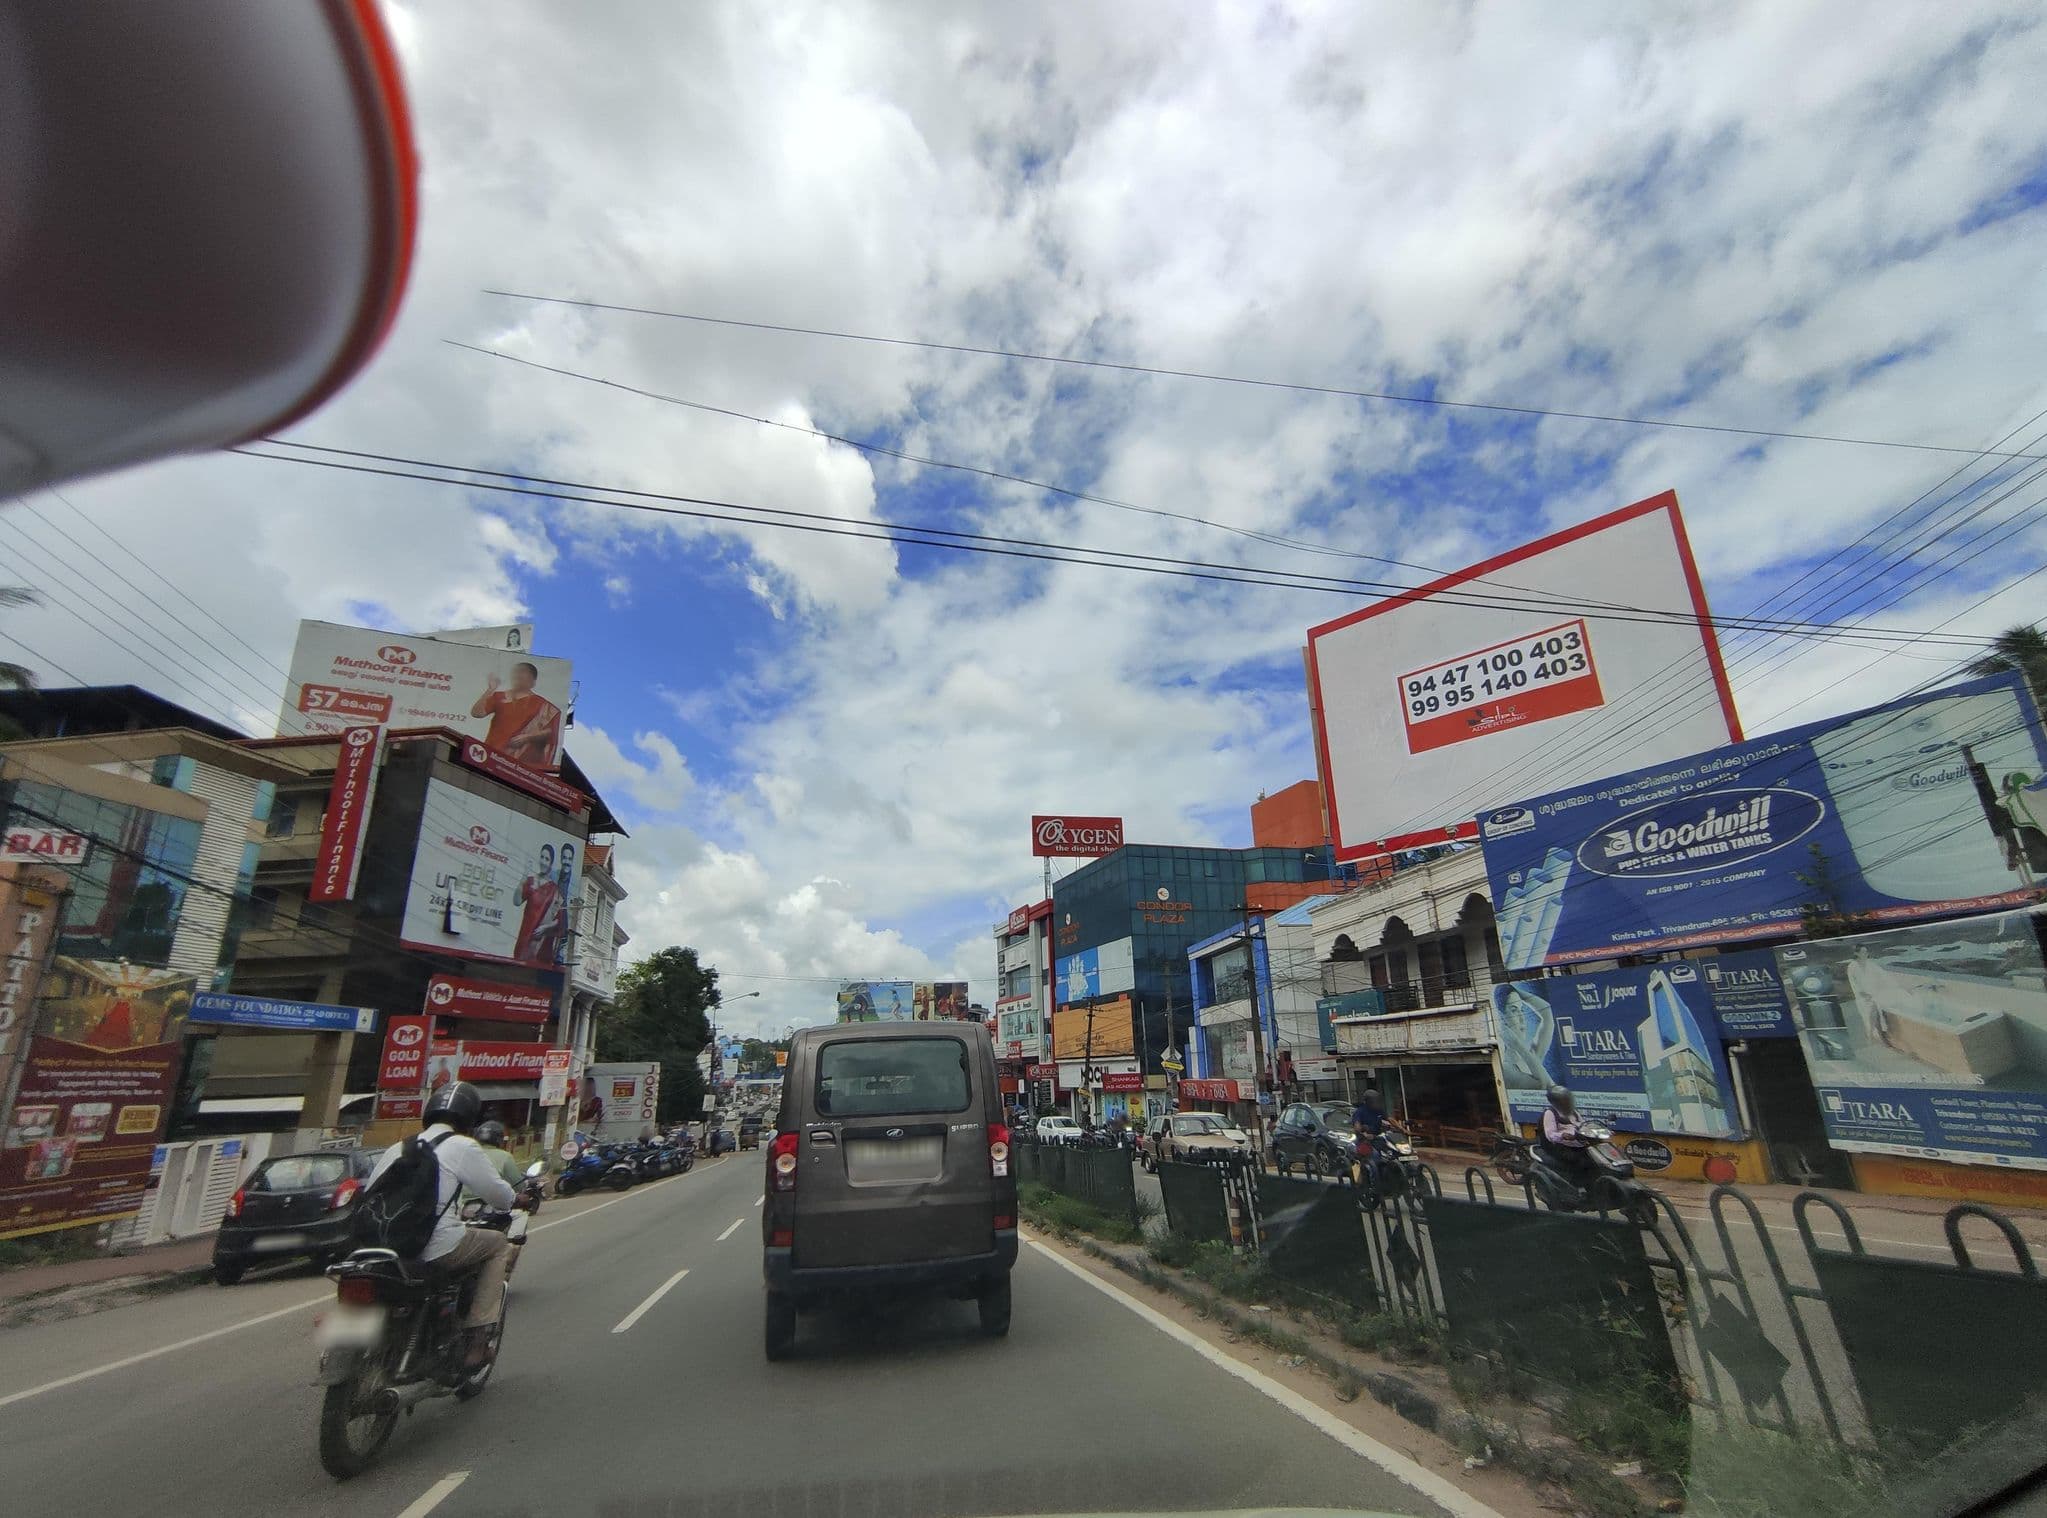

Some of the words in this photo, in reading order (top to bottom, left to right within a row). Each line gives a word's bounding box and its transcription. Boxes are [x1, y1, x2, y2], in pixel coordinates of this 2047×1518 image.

[334, 655, 396, 674] Muthoot
[399, 665, 453, 682] Finance
[1408, 675, 1437, 698] 94
[1441, 664, 1470, 686] 47
[1476, 648, 1523, 676] 100
[1529, 631, 1582, 660] 403
[1411, 694, 1440, 717] 99
[1444, 684, 1475, 707] 95
[1480, 669, 1527, 696] 140
[1534, 653, 1587, 681] 403
[307, 688, 340, 709] 57
[1471, 715, 1527, 733] ADVERTISING
[340, 747, 365, 821] Muthoot
[1619, 786, 1677, 807] Dedicated
[1679, 783, 1693, 792] to
[1036, 818, 1120, 847] OXYGEN
[1635, 795, 1772, 854] Goodwill
[8, 833, 83, 856] BAR
[443, 835, 480, 854] Muthoot
[479, 847, 510, 865] Finance
[1071, 845, 1099, 854] digital
[1100, 845, 1117, 853] sho
[1617, 860, 1640, 872] PVC
[1642, 853, 1674, 868] PIPES
[1676, 851, 1686, 862] &
[1687, 842, 1729, 860] WATER
[1728, 832, 1773, 850] TANKS
[324, 822, 347, 895] Finance
[1646, 887, 1658, 896] AN
[1659, 886, 1672, 894] ISO
[1673, 882, 1694, 893] 9001
[1722, 869, 1767, 884] COMPANY
[485, 906, 504, 920] LINE
[1136, 901, 1193, 911] CONDOR
[1143, 913, 1185, 924] PLAZA
[1611, 931, 1637, 942] Kinfra
[1637, 928, 1656, 938] Park
[1751, 912, 1769, 920] Ph:
[1559, 951, 1575, 961] PVC
[1728, 968, 1774, 985] TARA
[456, 987, 483, 1000] Muthoot
[1578, 989, 1601, 1004] No.1
[195, 995, 232, 1011] GEMS
[233, 999, 303, 1017] FOUNDATION
[1581, 1030, 1632, 1052] TARA
[388, 1049, 421, 1062] GOLD
[459, 1051, 510, 1068] Muthoot
[511, 1052, 547, 1068] Finan
[385, 1066, 418, 1079] LOAN
[642, 1064, 656, 1120] JOSCO
[1853, 1102, 1914, 1121] TARA
